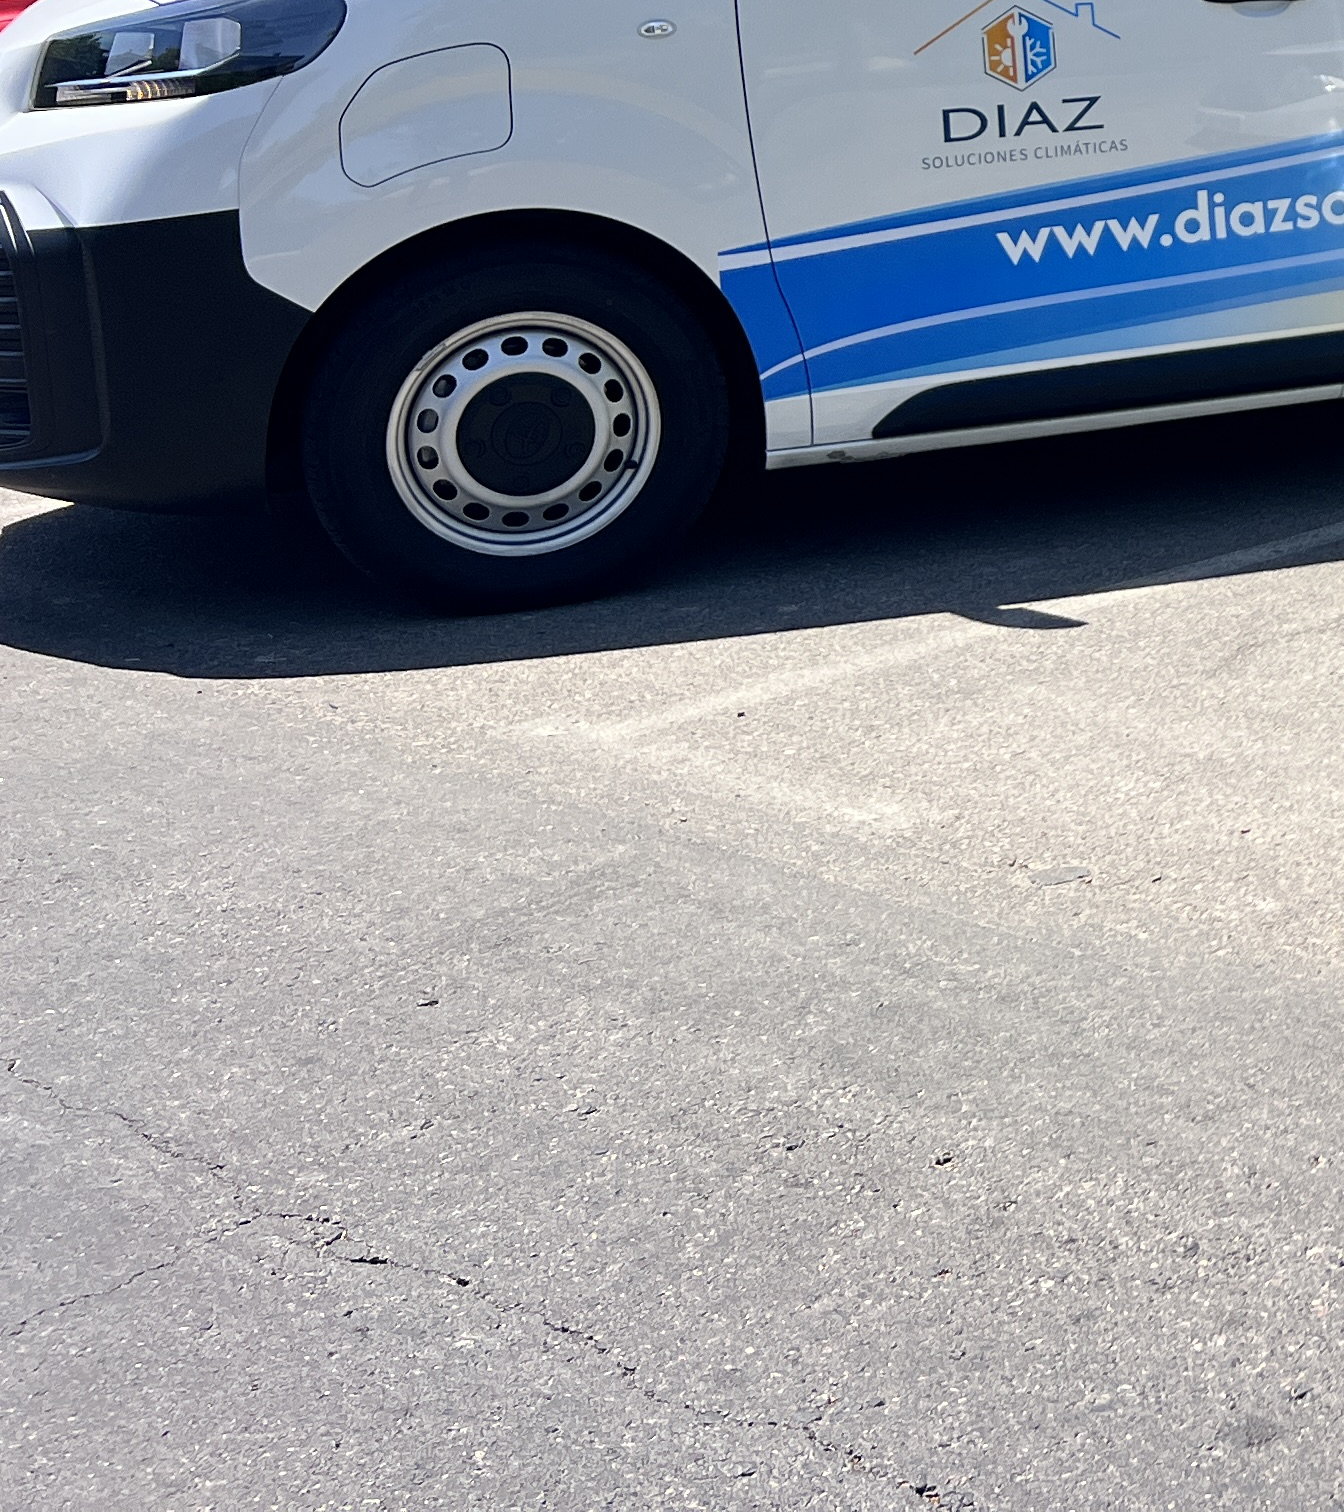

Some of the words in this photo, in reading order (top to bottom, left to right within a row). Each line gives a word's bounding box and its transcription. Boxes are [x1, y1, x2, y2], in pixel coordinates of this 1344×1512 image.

[942, 96, 1105, 143] DIAZ
[921, 148, 1029, 170] SOLUCIONES
[1034, 139, 1129, 159] CLIMÁTICAS
